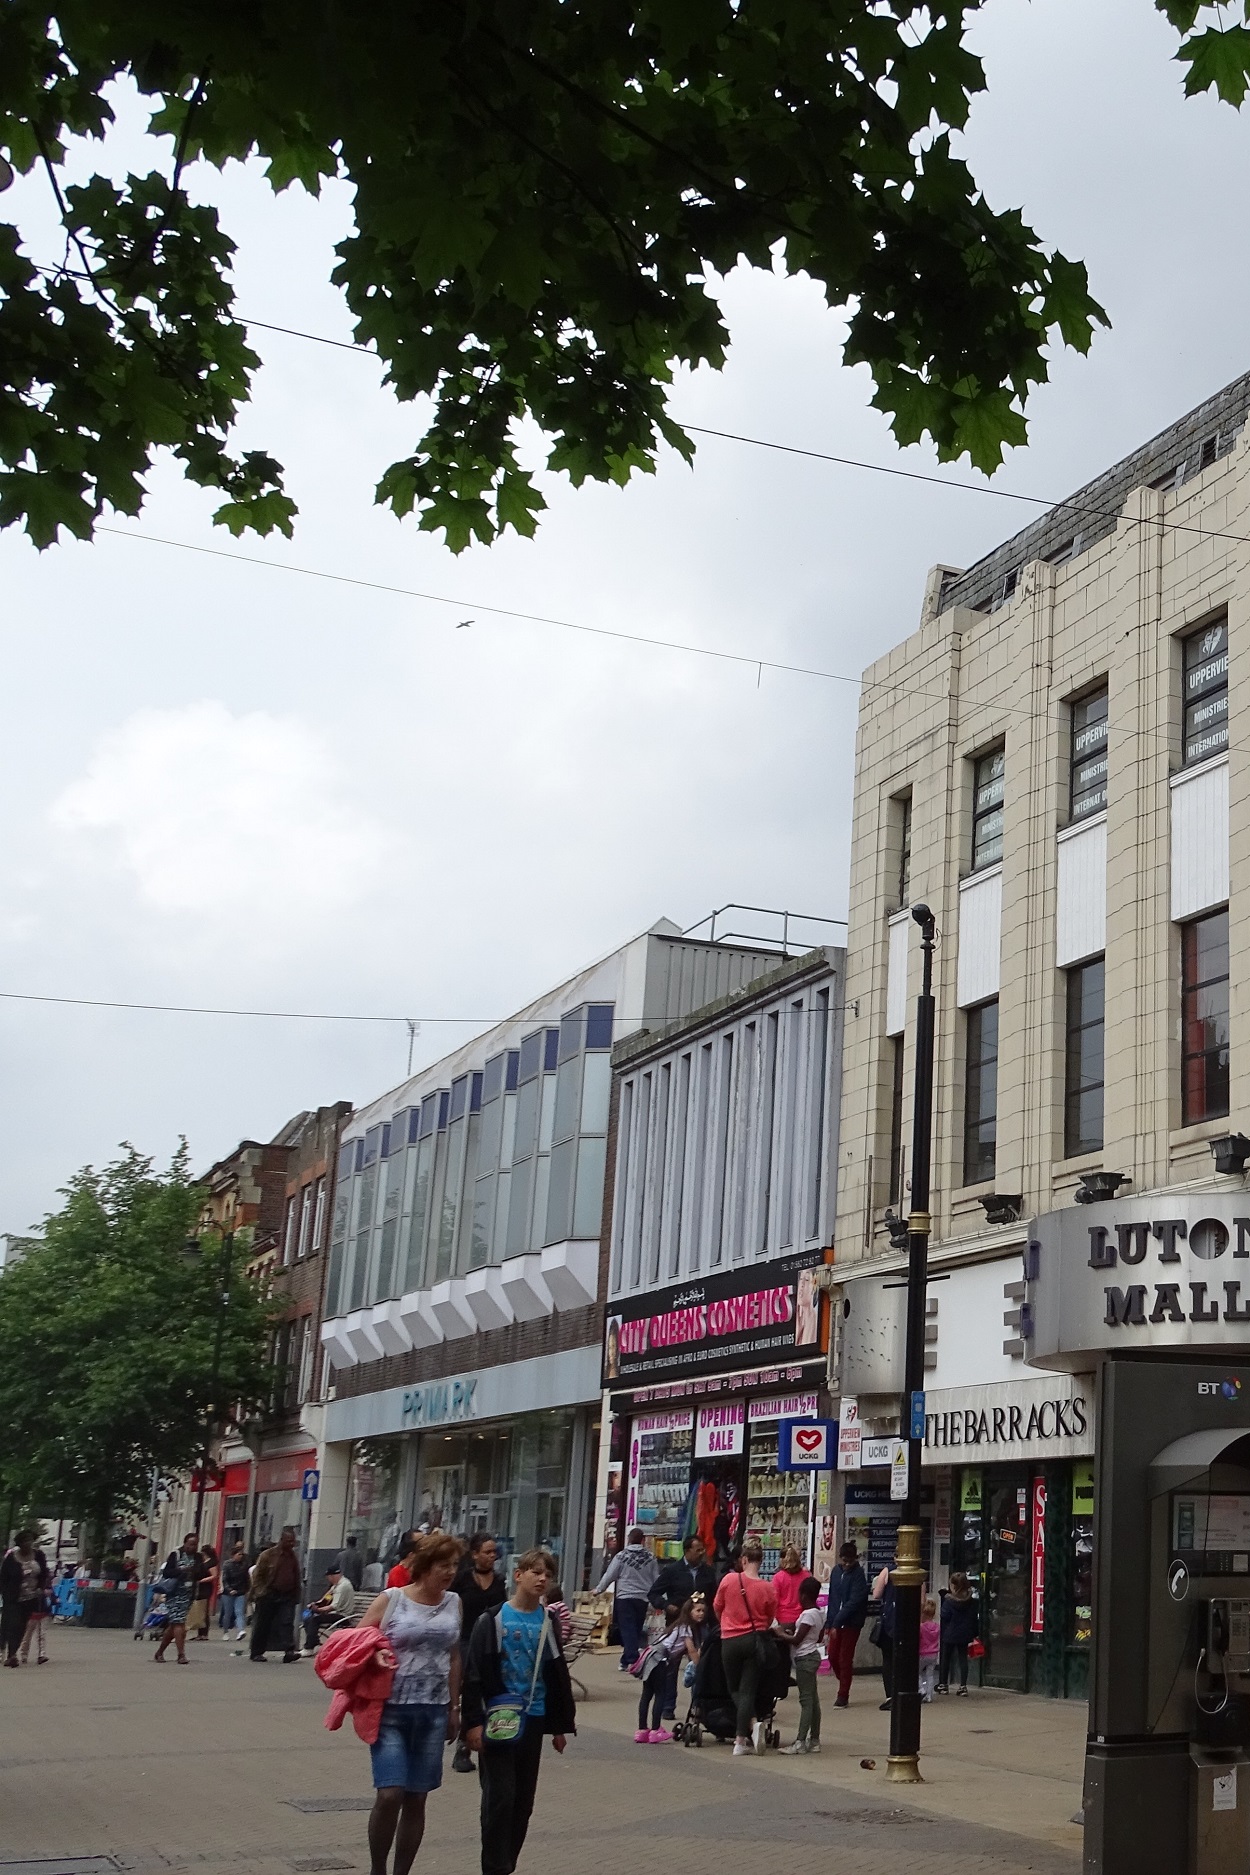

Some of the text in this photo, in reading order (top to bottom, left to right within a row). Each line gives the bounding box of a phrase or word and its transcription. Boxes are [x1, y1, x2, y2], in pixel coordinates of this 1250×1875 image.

[618, 1318, 650, 1355] CITY
[650, 1305, 707, 1348] QUEENS
[707, 1285, 794, 1336] COSMETICS
[1197, 1382, 1220, 1395] BT
[401, 1378, 477, 1427] PRIMARK
[750, 1401, 781, 1418] BRAZILIAN
[783, 1396, 799, 1413] HAIR
[700, 1403, 744, 1430] OPENING
[708, 1430, 734, 1452] SALE
[868, 1445, 888, 1458] UCKG
